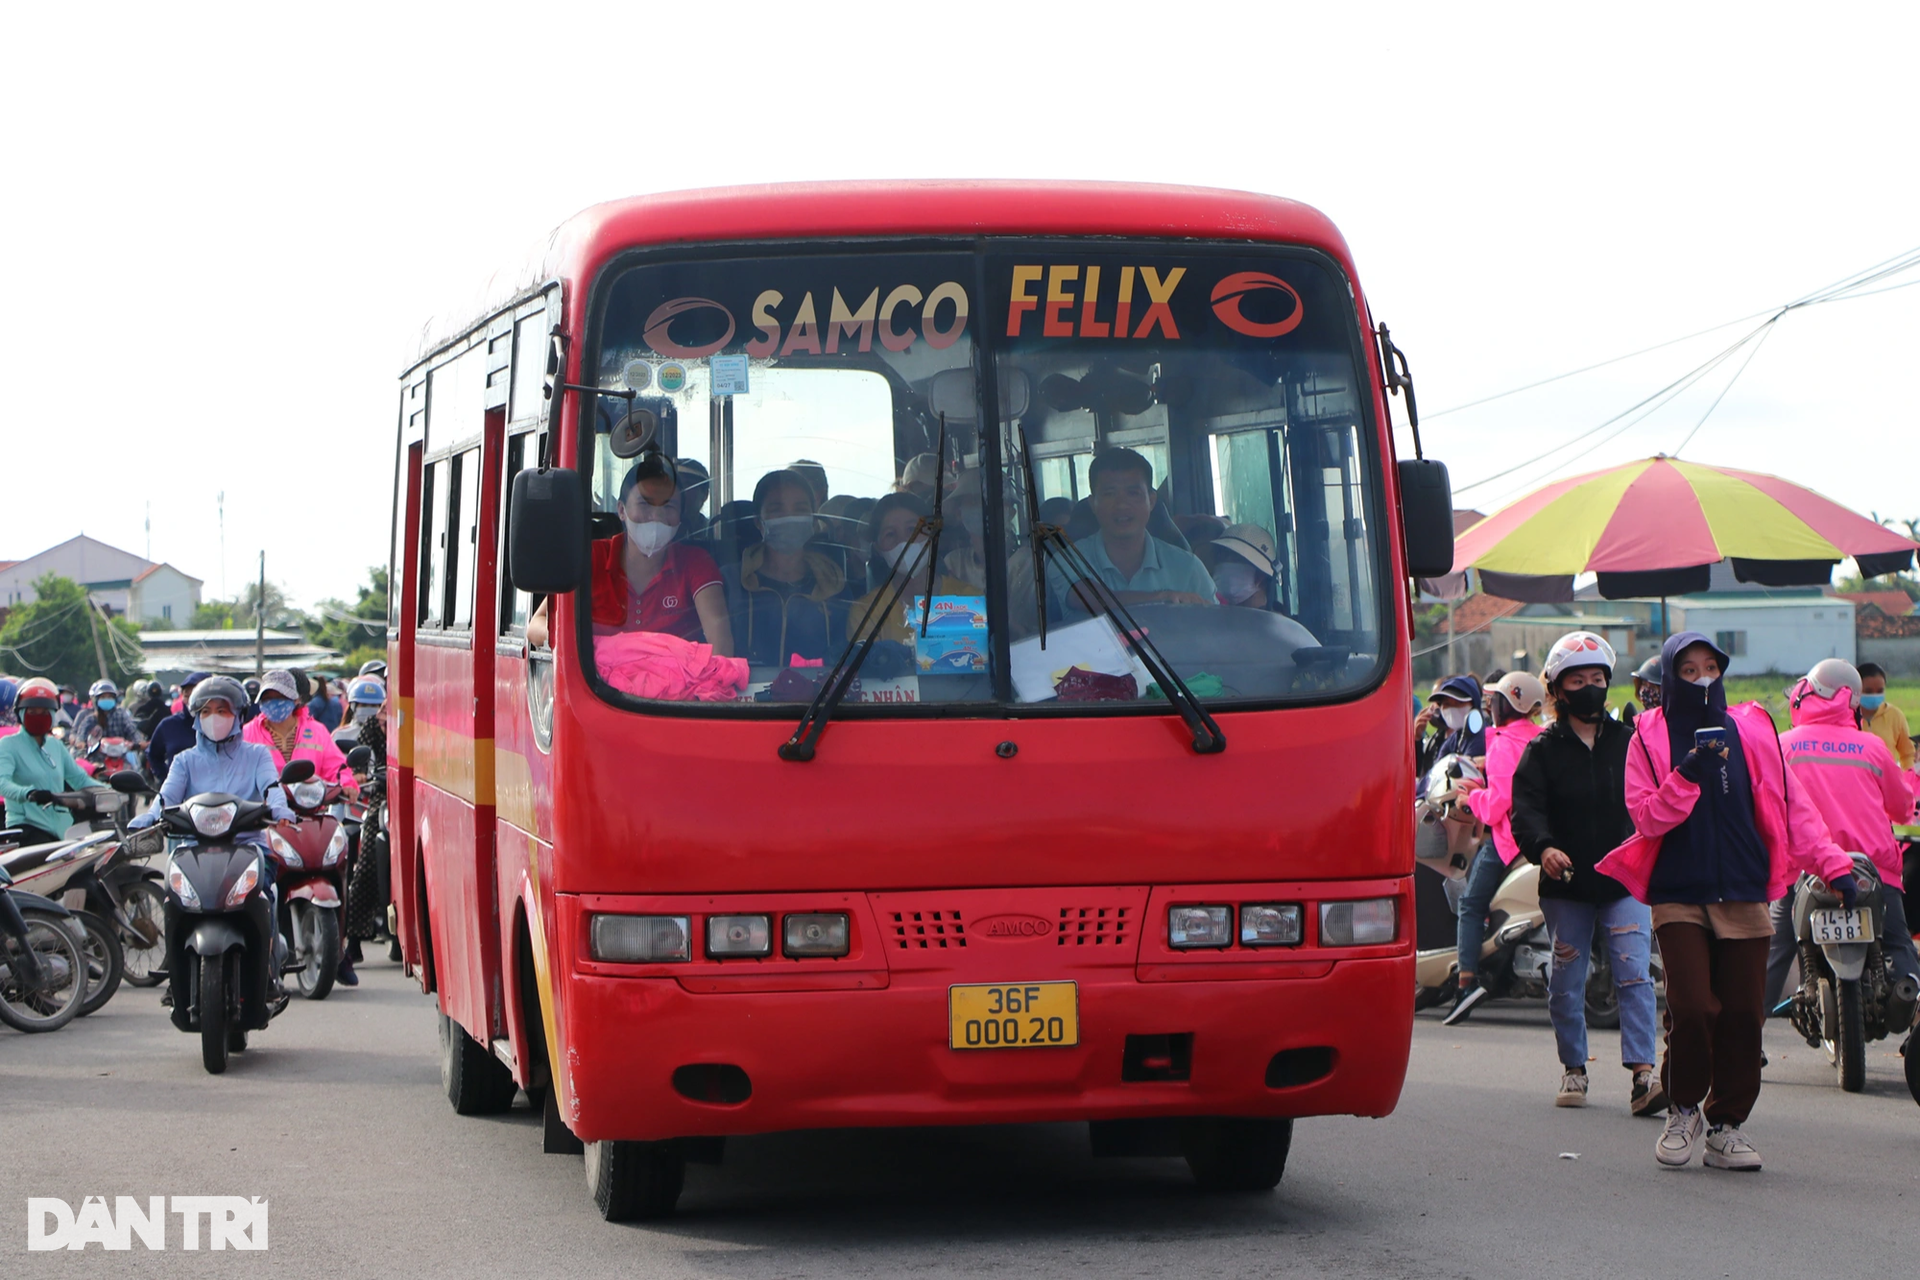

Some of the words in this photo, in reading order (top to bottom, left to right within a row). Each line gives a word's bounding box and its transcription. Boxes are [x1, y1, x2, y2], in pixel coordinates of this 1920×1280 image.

[745, 281, 969, 358] SAMCO
[1006, 265, 1187, 339] FELIX
[934, 601, 953, 610] 4N
[873, 685, 915, 704] NHÂN
[1791, 740, 1818, 751] VIET
[1822, 742, 1864, 754] GLORY
[986, 920, 1049, 936] AMCO
[1821, 926, 1863, 941] 5981
[987, 986, 1040, 1014] 36F
[965, 1017, 1064, 1045] 000.20
